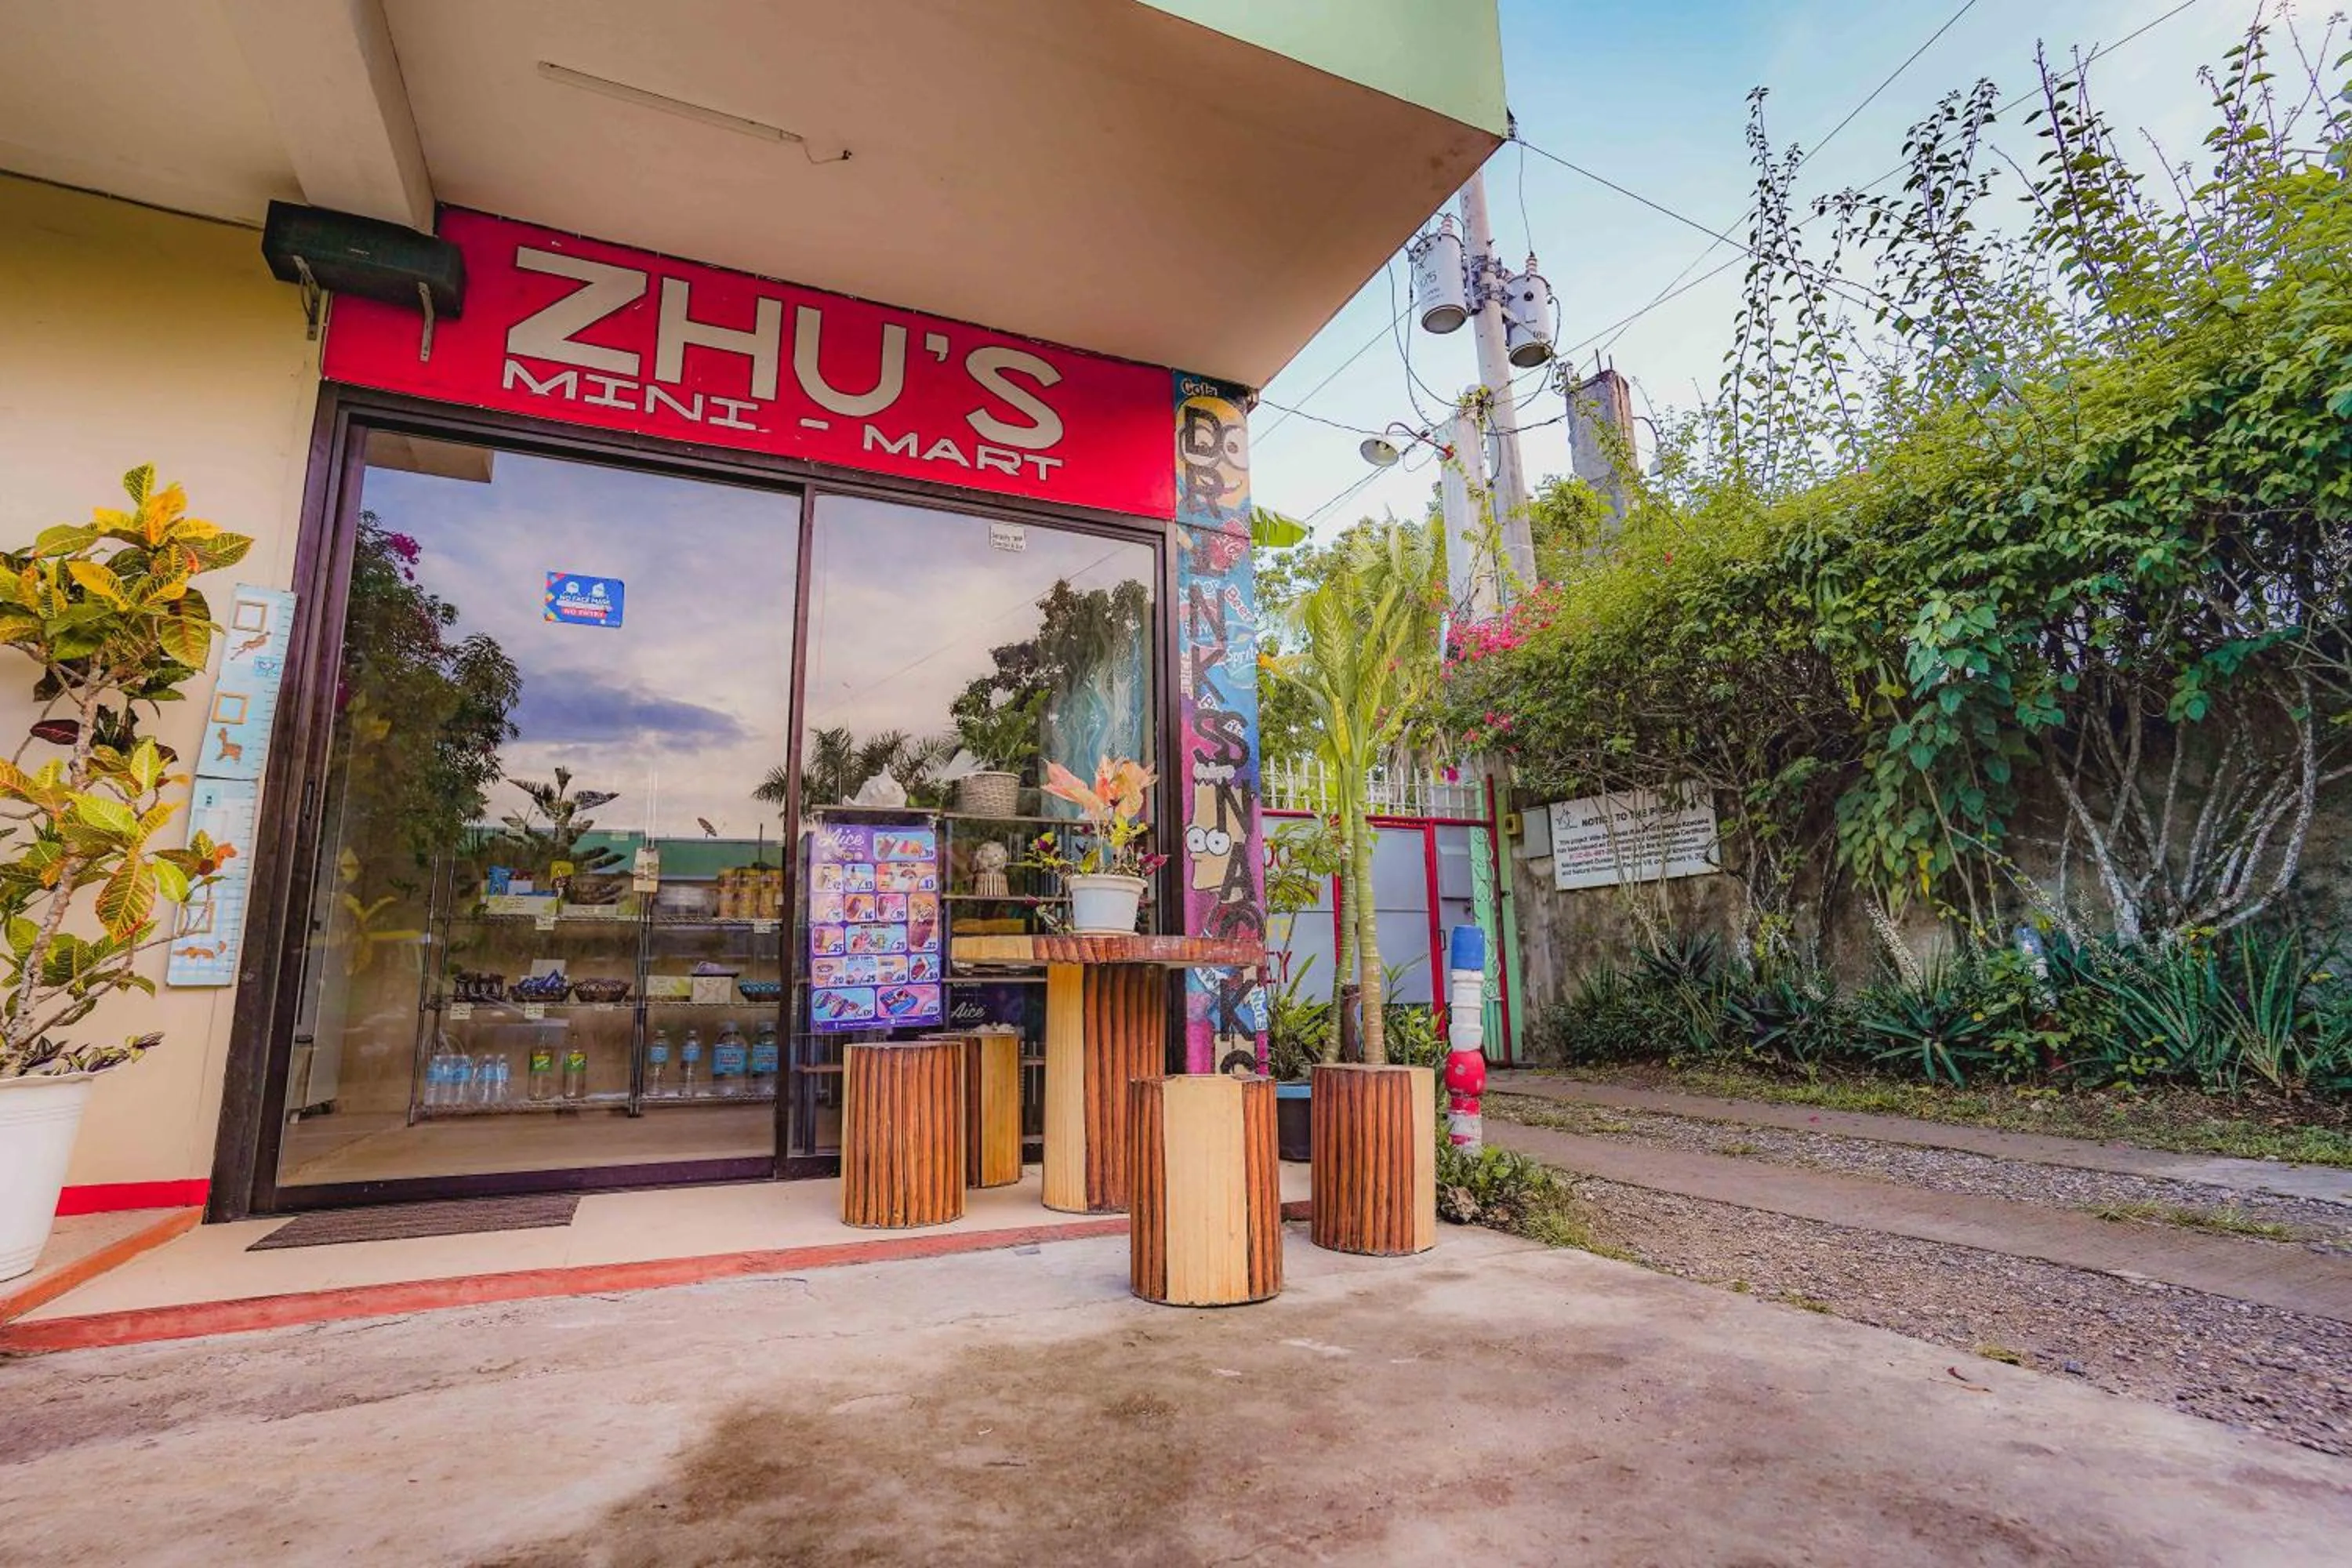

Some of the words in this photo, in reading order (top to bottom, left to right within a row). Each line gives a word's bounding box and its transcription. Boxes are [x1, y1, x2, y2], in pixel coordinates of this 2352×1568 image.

[506, 245, 1064, 449] ZHU'S
[503, 358, 760, 430] MINI
[862, 425, 1063, 481] MART
[1185, 405, 1229, 766] DRINKS
[1226, 643, 1257, 664] Sprit
[1581, 814, 1613, 827] NOTIC
[1615, 812, 1627, 822] TO
